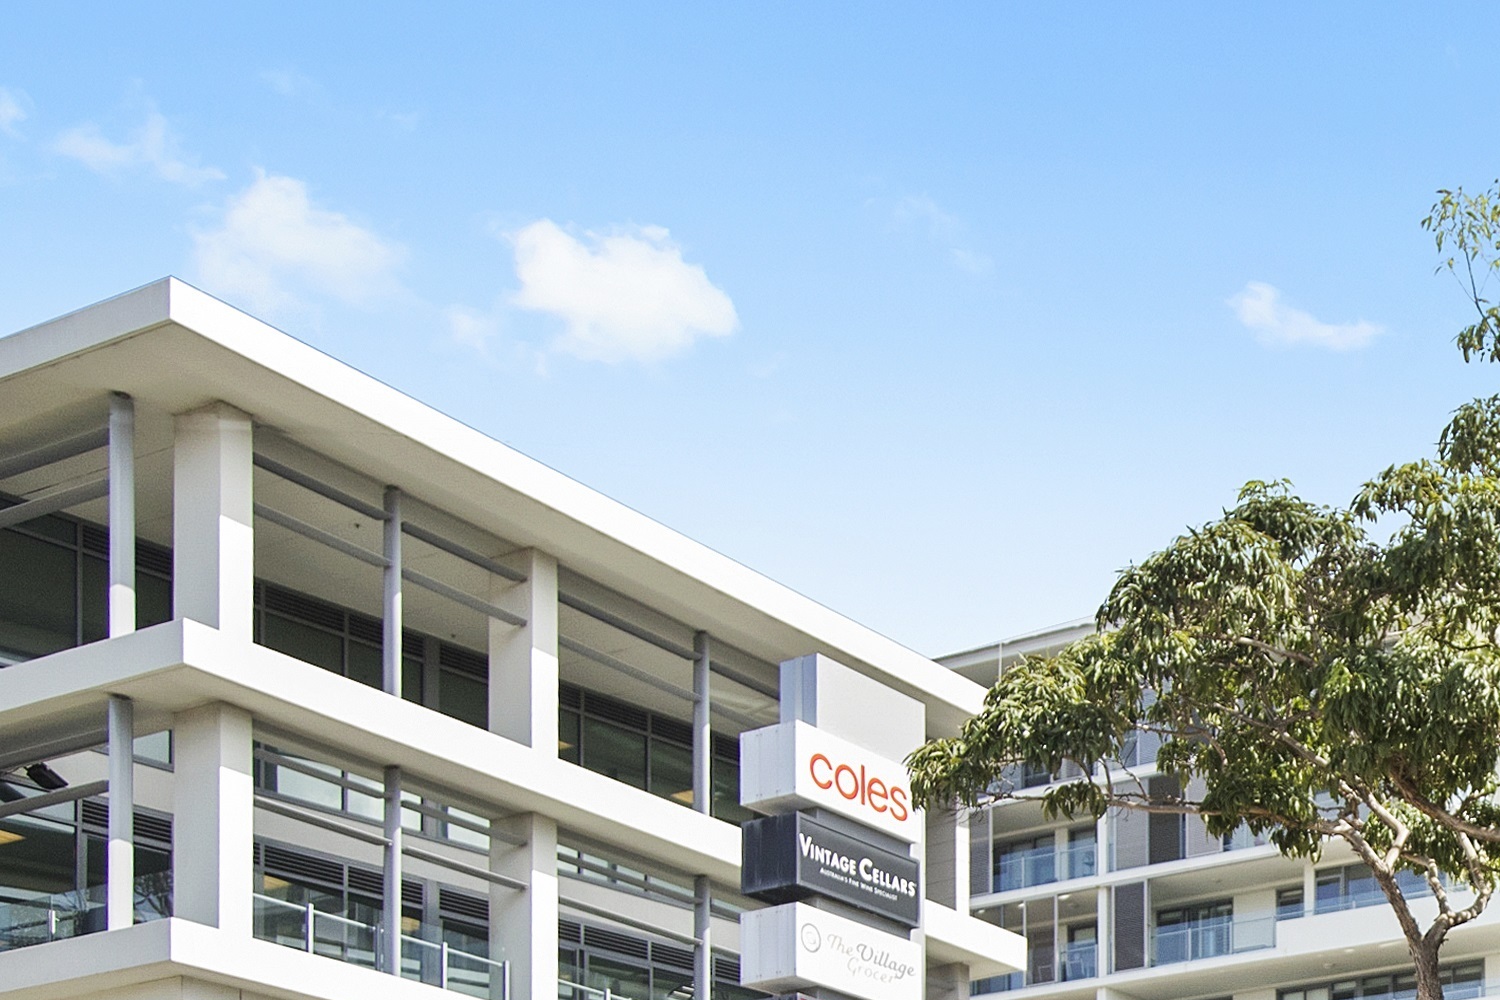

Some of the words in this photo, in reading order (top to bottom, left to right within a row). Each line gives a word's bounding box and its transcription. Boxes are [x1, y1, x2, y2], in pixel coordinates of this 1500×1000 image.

[810, 753, 908, 821] coles
[799, 833, 856, 875] VINTAGE
[859, 858, 916, 897] CELLARS
[827, 934, 853, 956] The
[856, 943, 916, 979] Village
[847, 957, 895, 983] Grocer
